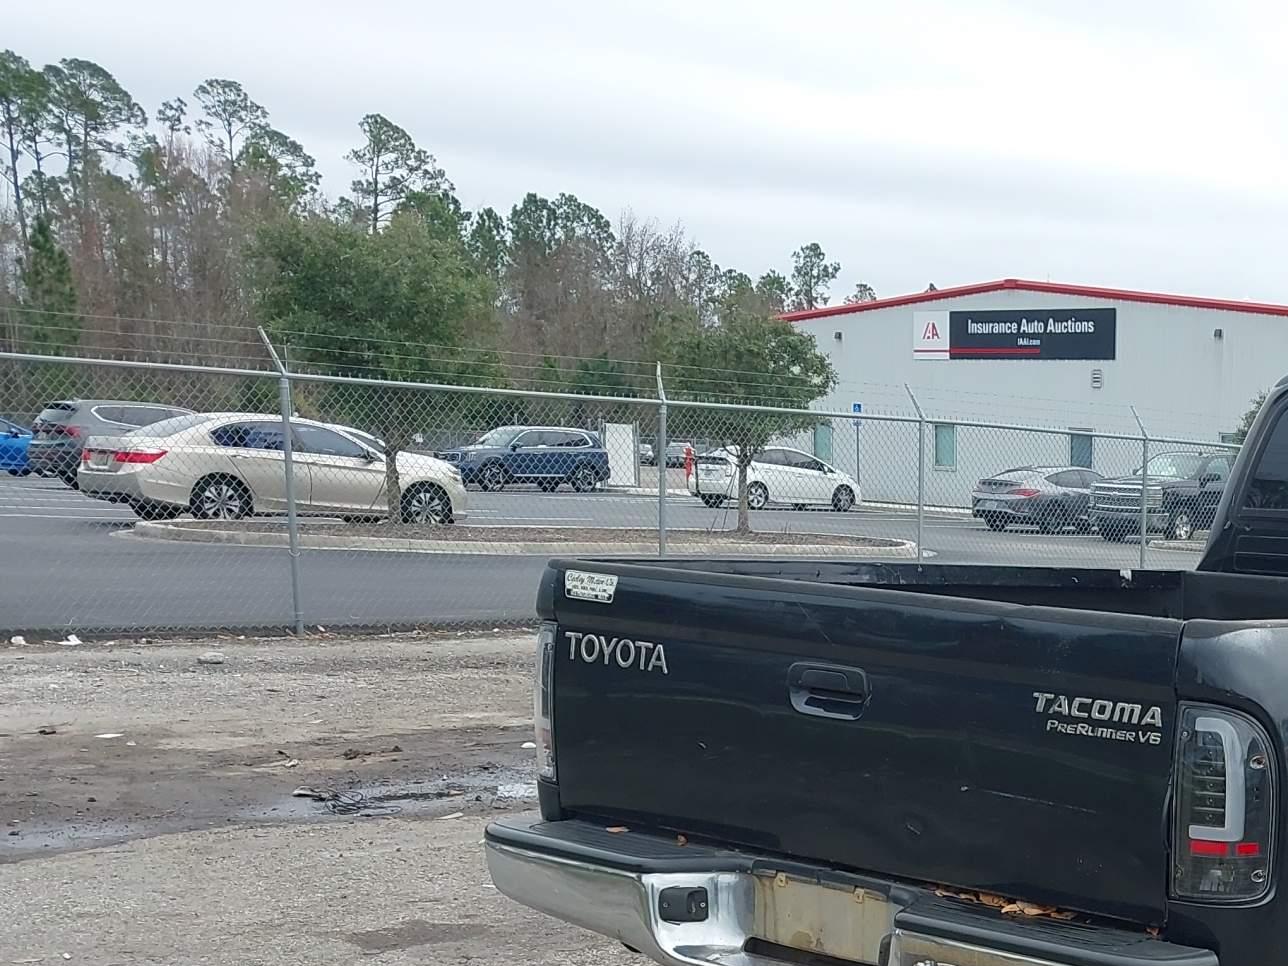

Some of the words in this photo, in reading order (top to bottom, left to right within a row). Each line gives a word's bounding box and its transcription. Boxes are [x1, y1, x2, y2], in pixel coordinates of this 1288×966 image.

[967, 318, 1018, 334] Insurance
[1020, 319, 1044, 333] Auto
[1047, 317, 1095, 333] Auctions
[565, 632, 668, 674] TOYOTA
[1033, 692, 1162, 727] TACOMA
[1139, 731, 1161, 745] V6
